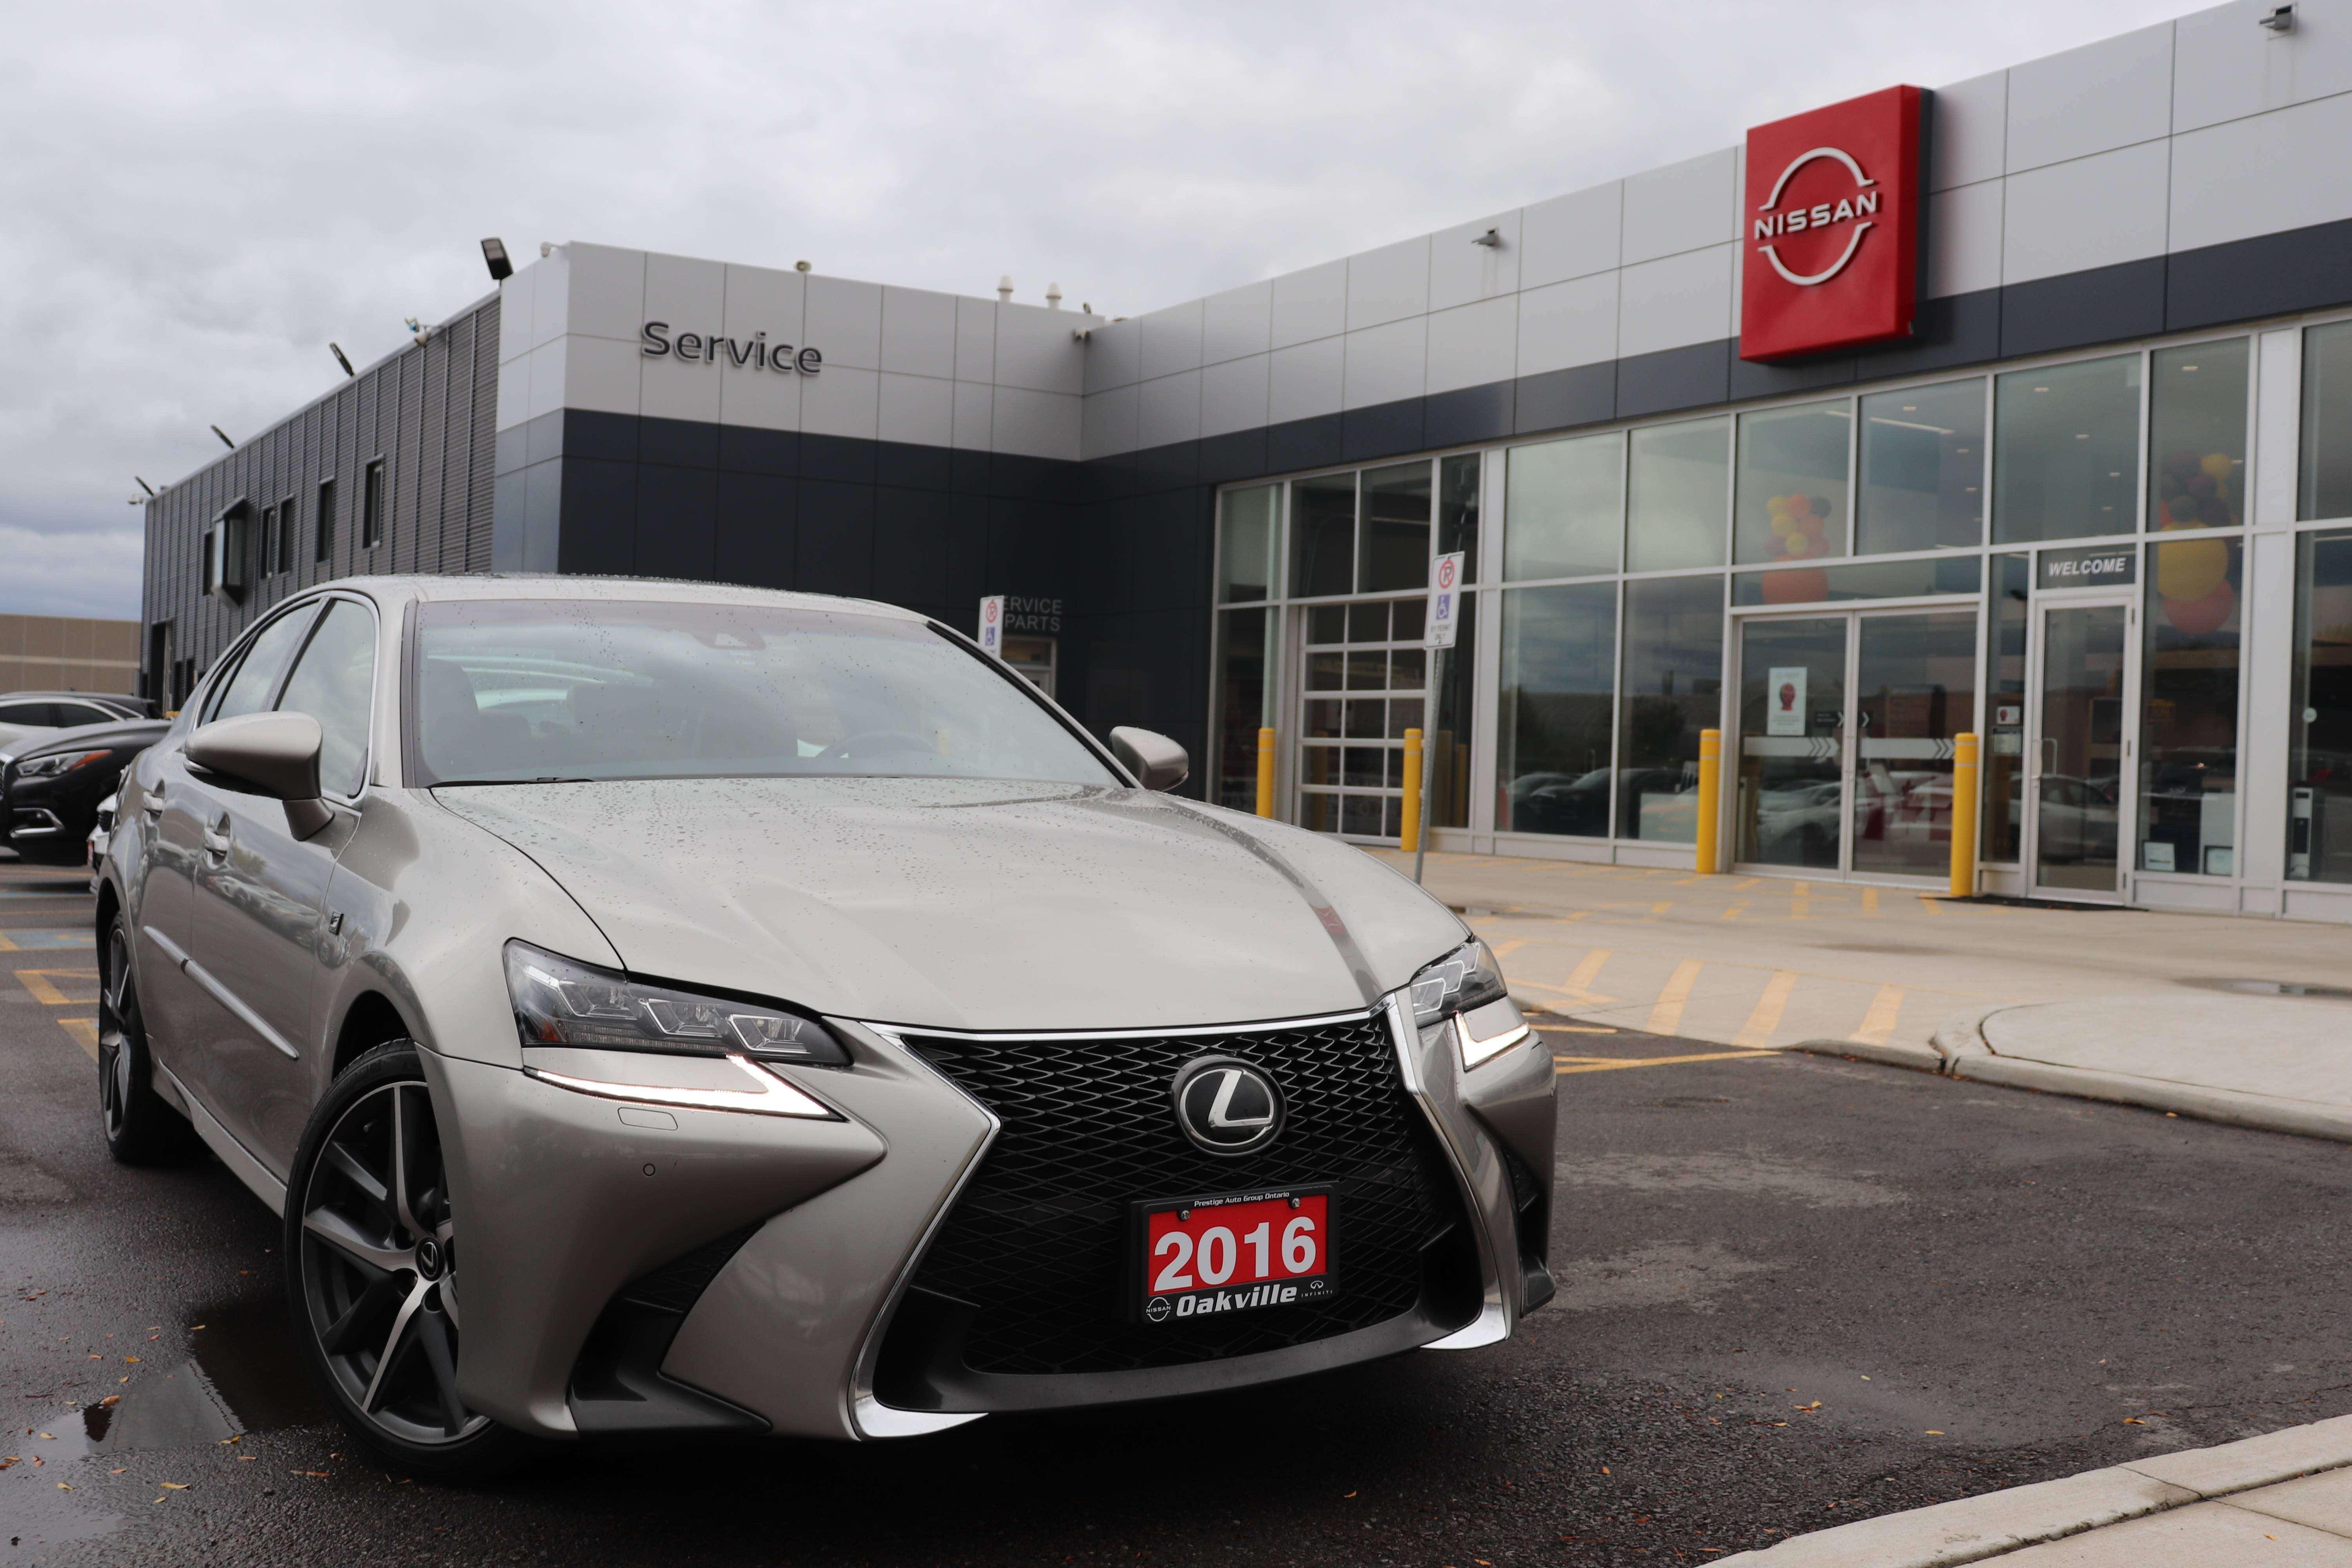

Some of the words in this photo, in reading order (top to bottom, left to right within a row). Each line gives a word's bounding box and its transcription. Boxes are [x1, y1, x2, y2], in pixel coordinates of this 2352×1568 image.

[1754, 191, 1877, 240] NISSAN
[642, 321, 822, 376] Service
[2048, 557, 2126, 577] WELCOME
[1005, 614, 1061, 632] PARTS
[1154, 1216, 1316, 1291] 2016
[1146, 1305, 1171, 1313] NISSAN
[1176, 1284, 1297, 1317] Oakville
